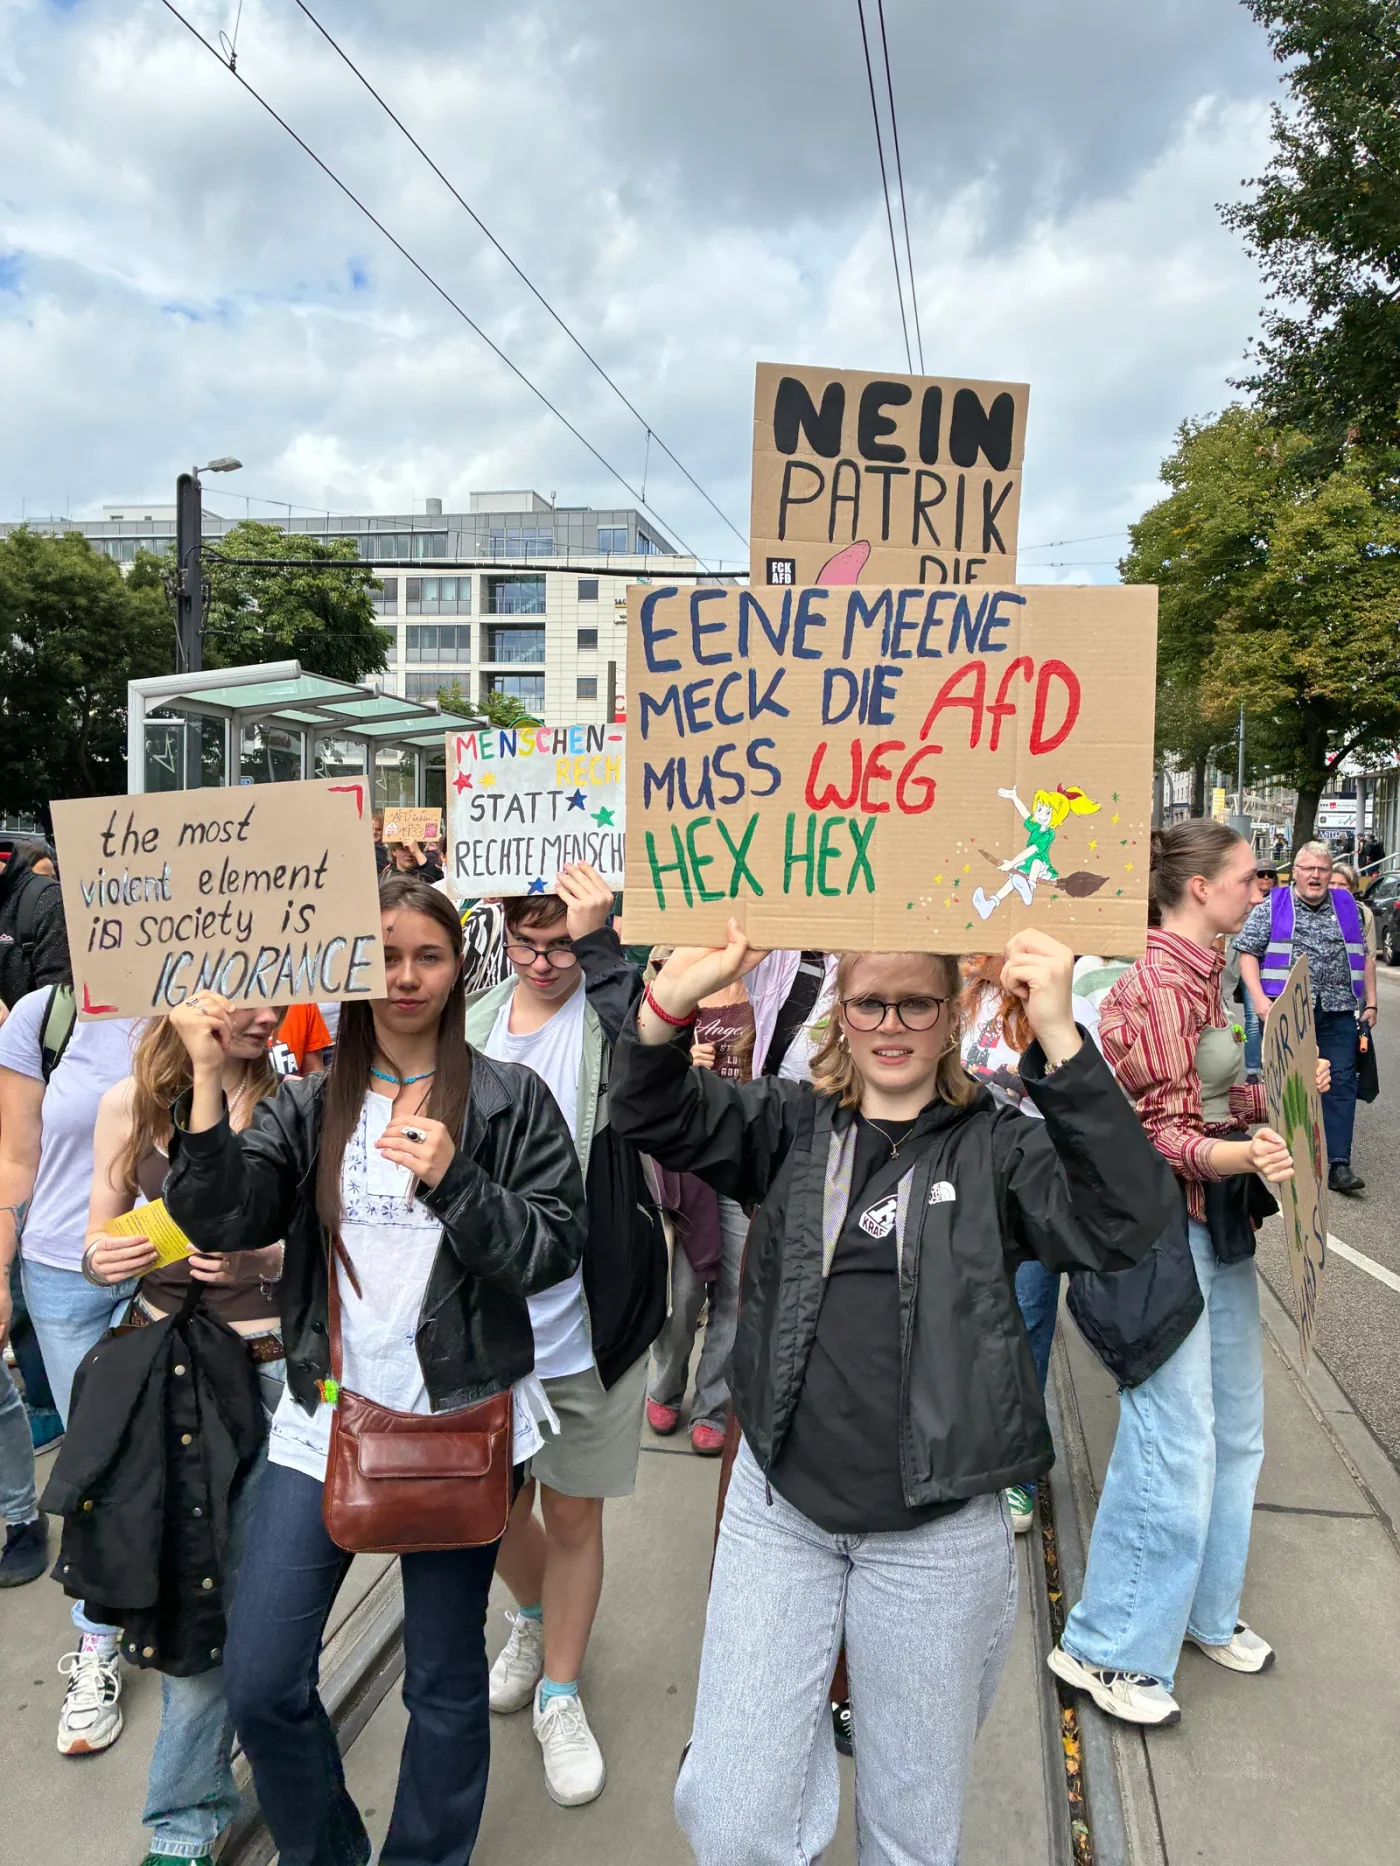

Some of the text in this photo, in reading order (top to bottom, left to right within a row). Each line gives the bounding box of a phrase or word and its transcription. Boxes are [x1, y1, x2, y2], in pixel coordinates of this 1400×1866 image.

[773, 376, 1015, 472] NEIN
[778, 458, 1014, 554] PATRIK
[772, 561, 791, 573] FCK
[772, 573, 791, 584] AFD
[640, 587, 1027, 673] EENE MEENE
[639, 655, 1081, 755] MECK DIE AfD
[456, 724, 623, 764] MENSCHEN-
[644, 737, 944, 814] MUSS WEG
[100, 803, 255, 858] the most
[470, 790, 564, 823] STATT
[80, 849, 329, 908] violent element
[455, 831, 626, 878] RECHTE MENSCH
[645, 812, 877, 911] HEX HEX
[135, 900, 253, 943] society
[281, 900, 316, 934] is
[151, 934, 377, 1008] IGNORANCE
[696, 1018, 743, 1043] Ange
